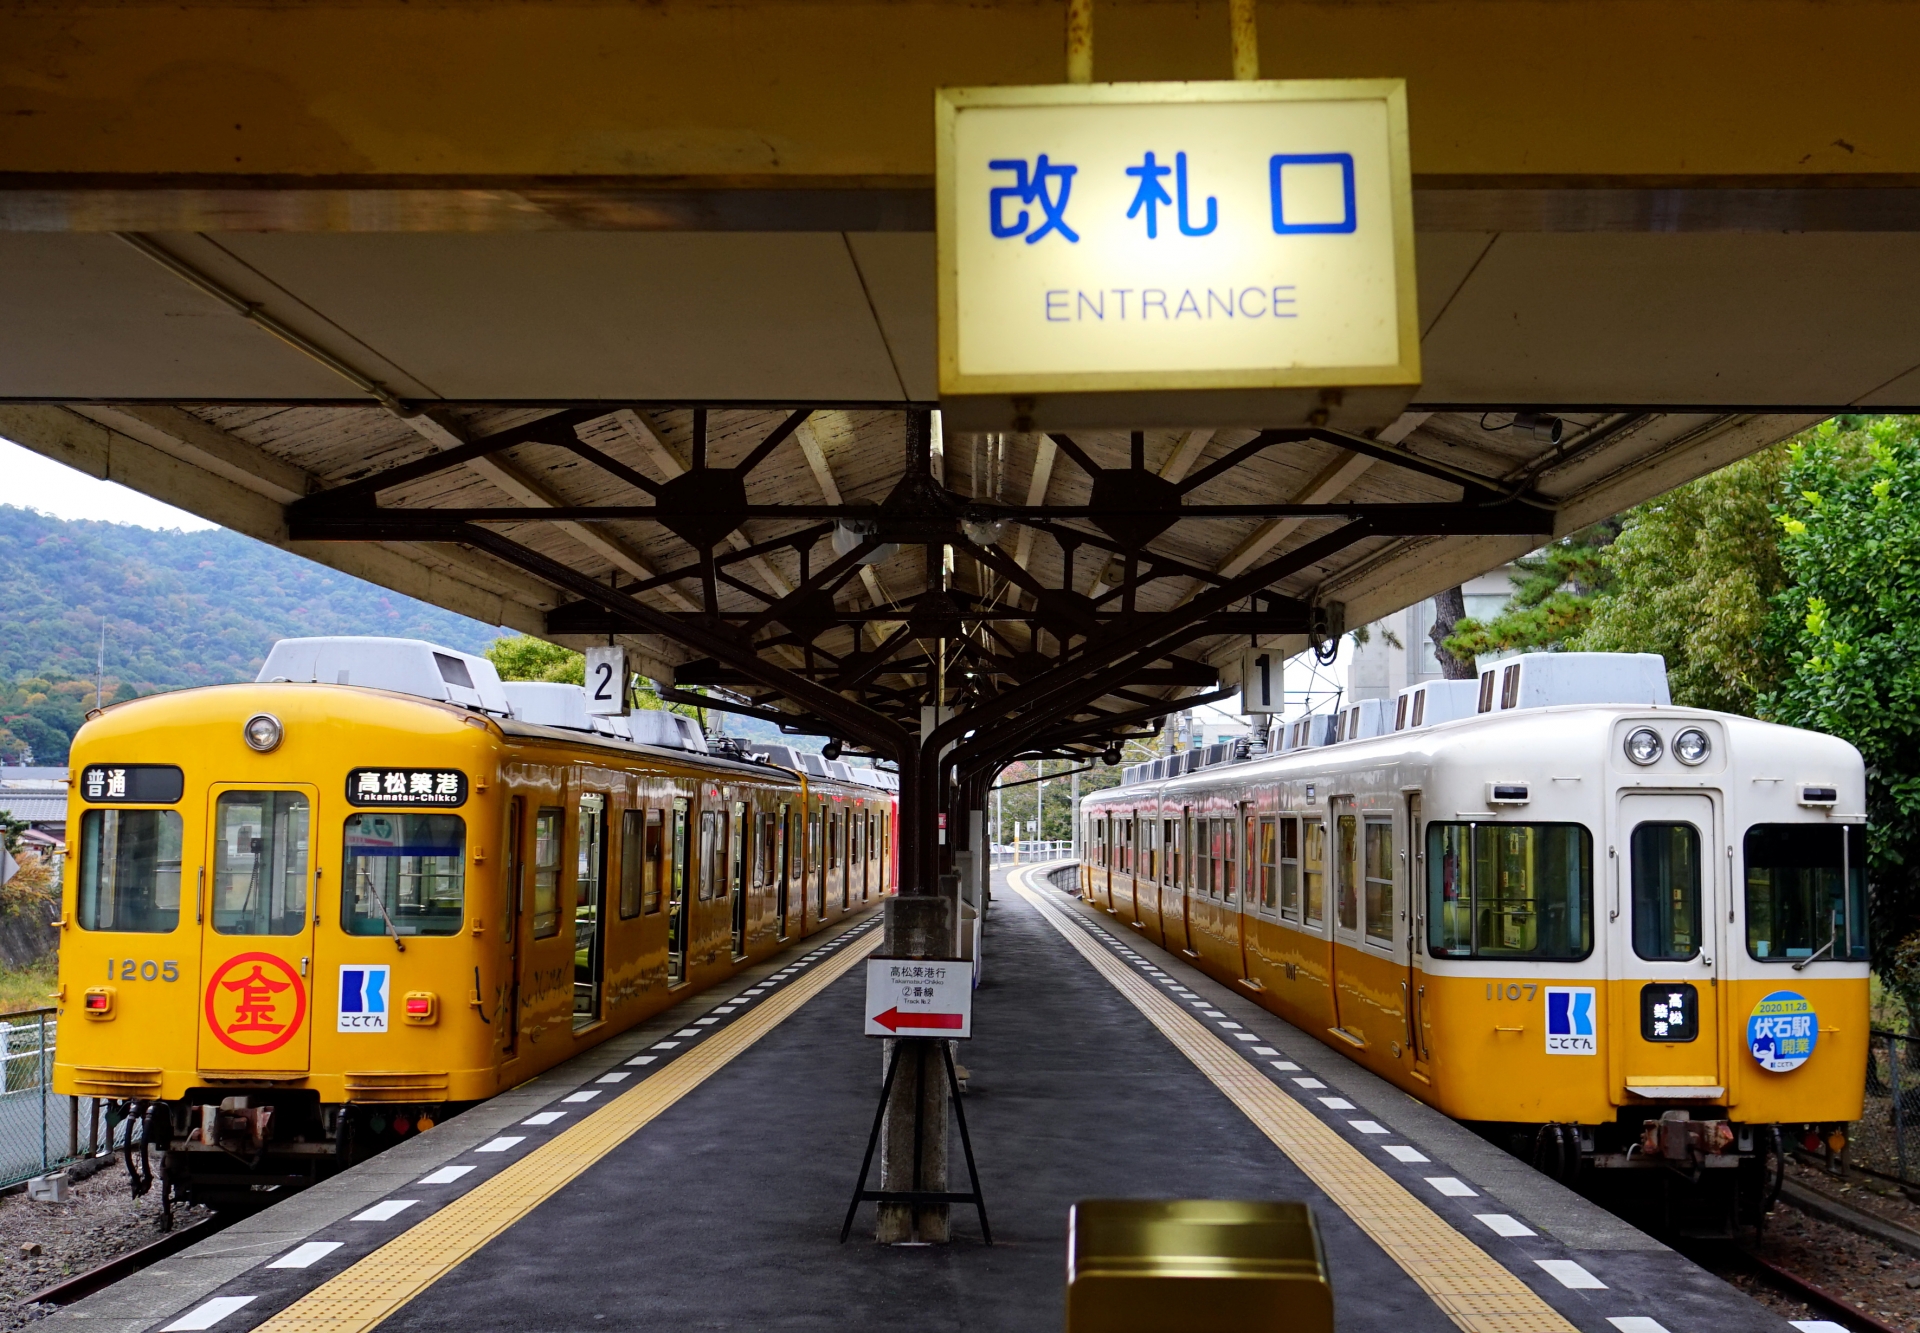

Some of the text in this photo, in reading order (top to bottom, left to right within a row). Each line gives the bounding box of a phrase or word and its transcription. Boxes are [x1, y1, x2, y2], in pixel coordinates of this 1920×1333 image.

[988, 150, 1357, 244] 改札口
[1046, 286, 1298, 321] ENTRANCE
[594, 662, 613, 700] 2
[1255, 653, 1270, 706] 1
[87, 769, 126, 797] 普通
[358, 772, 458, 794] 高松築港
[357, 793, 457, 802] Takamatsu-Chikko
[108, 959, 180, 982] 1205
[890, 966, 946, 978] 高松築港行
[1486, 983, 1537, 1001] 1107
[1668, 993, 1683, 1025] 高松
[1760, 1003, 1808, 1013] 2020.11.28
[341, 1015, 385, 1027] ことでん
[1754, 1016, 1811, 1039] 伏石駅
[1549, 1038, 1593, 1049] ことでん
